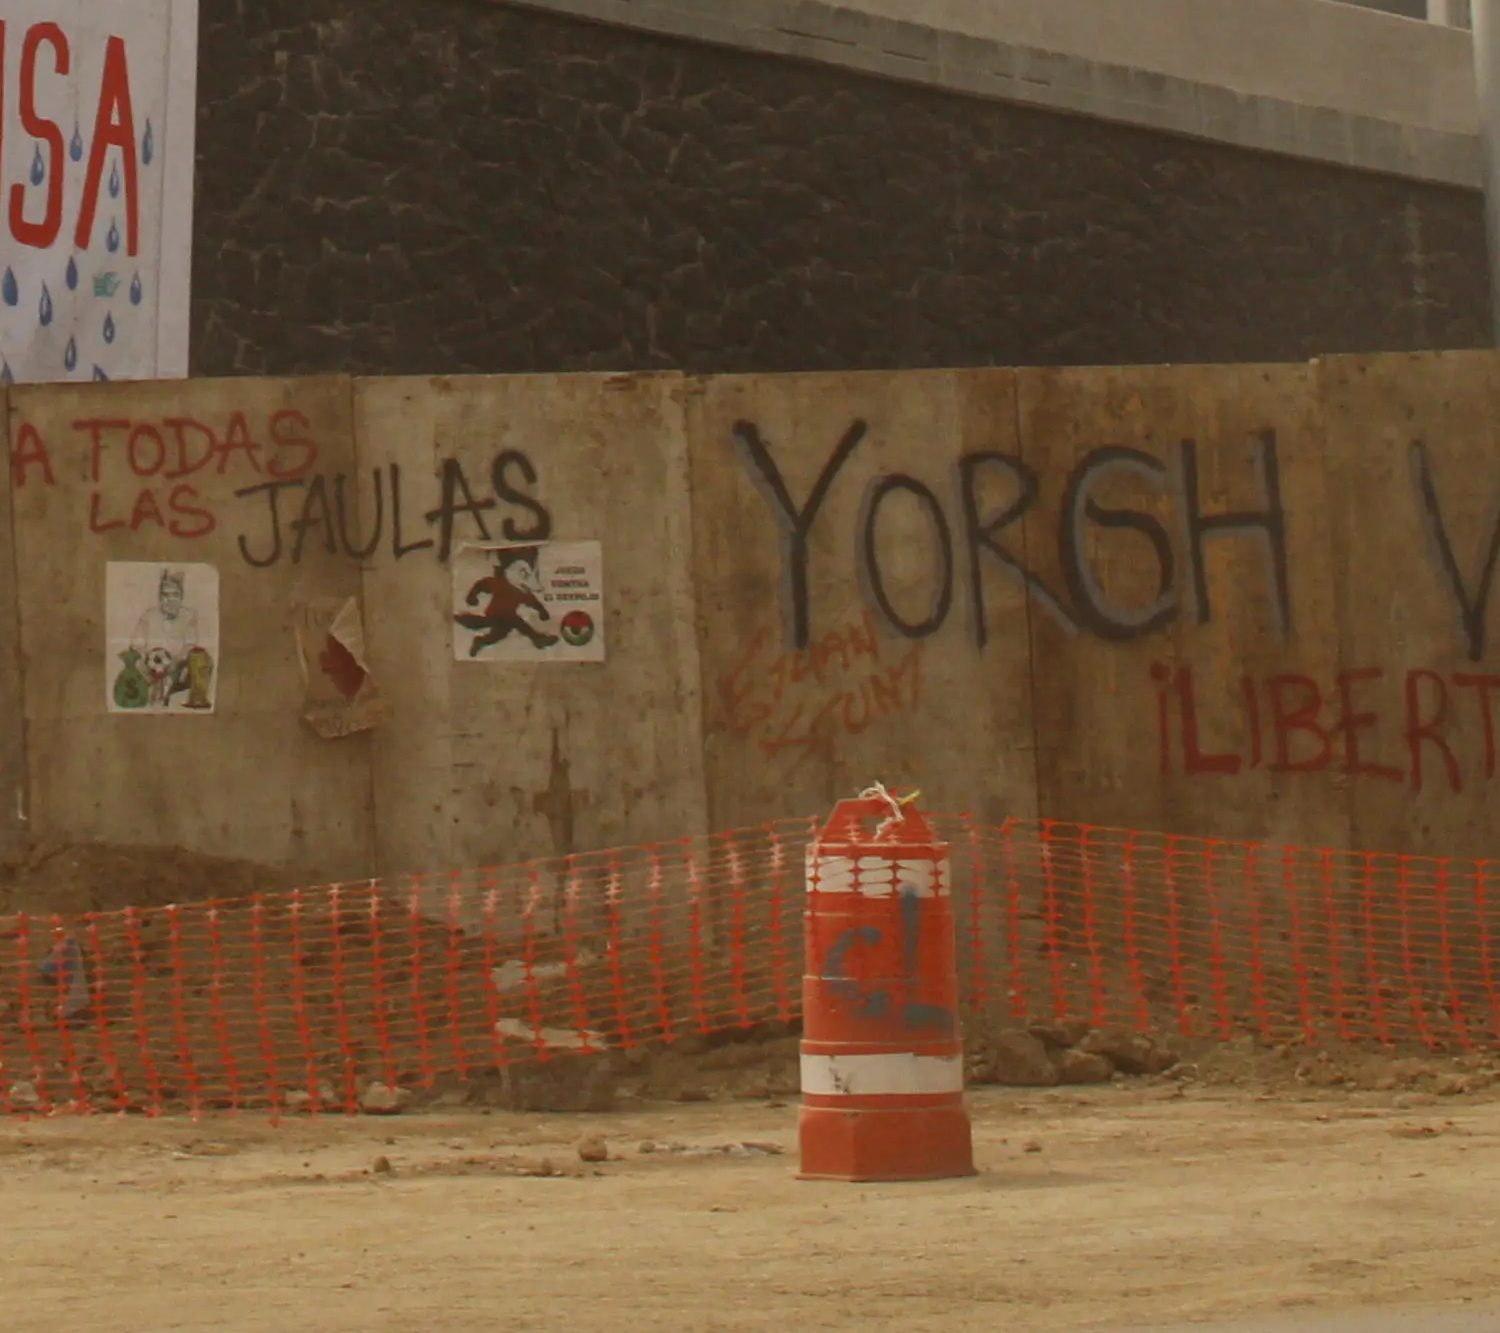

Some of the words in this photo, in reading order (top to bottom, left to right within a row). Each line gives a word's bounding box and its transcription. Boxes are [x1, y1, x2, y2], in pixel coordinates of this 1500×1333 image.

[12, 422, 57, 488] A
[72, 408, 320, 483] TODAS
[87, 484, 216, 539] LAS
[234, 447, 552, 569] JAULAS
[731, 417, 1292, 651] YORGH
